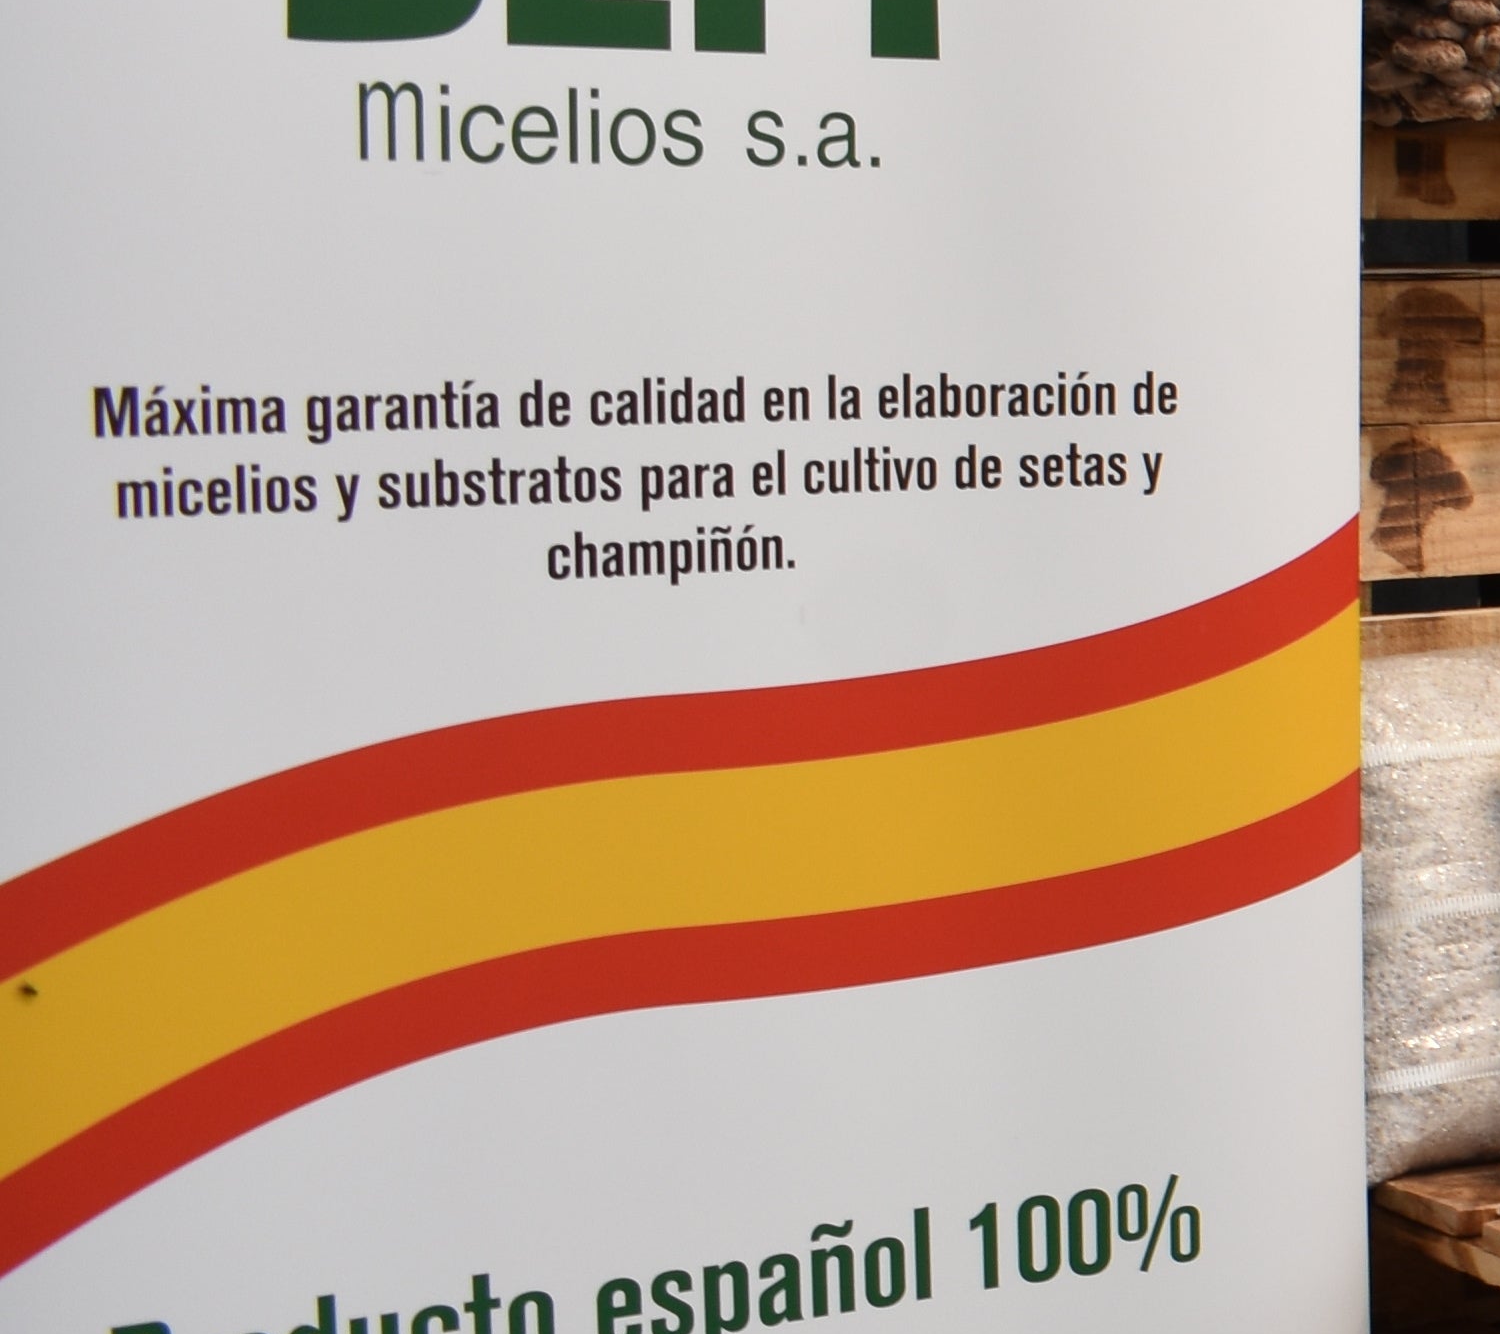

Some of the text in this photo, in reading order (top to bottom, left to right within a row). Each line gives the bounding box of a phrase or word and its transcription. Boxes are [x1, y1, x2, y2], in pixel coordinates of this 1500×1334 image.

[745, 109, 881, 169] s.a.
[93, 369, 1178, 445] Máxima garantía de calidad en la elaboración de
[116, 441, 1164, 524] micelios y substratos para el cultivo de setas y
[547, 523, 796, 587] champiñón.
[968, 1173, 1202, 1291] 100%
